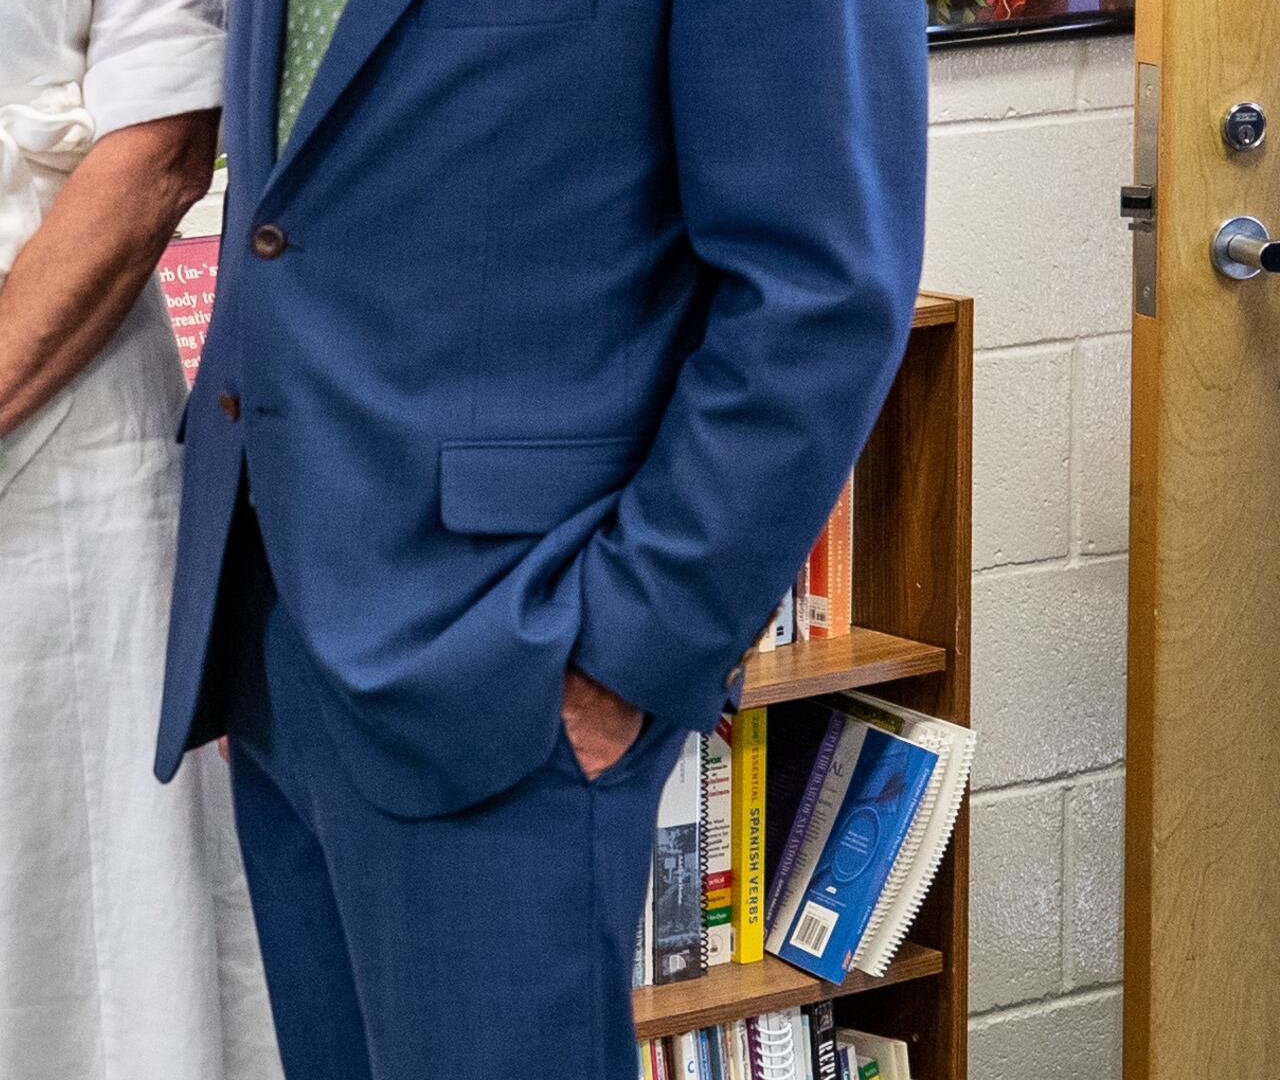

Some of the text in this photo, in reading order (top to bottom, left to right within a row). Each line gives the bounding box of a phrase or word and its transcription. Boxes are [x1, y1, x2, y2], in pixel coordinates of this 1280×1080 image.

[167, 292, 197, 308] body
[751, 747, 760, 802] ESSENTIAL
[749, 807, 760, 871] SPANISH
[748, 875, 759, 924] VERBS
